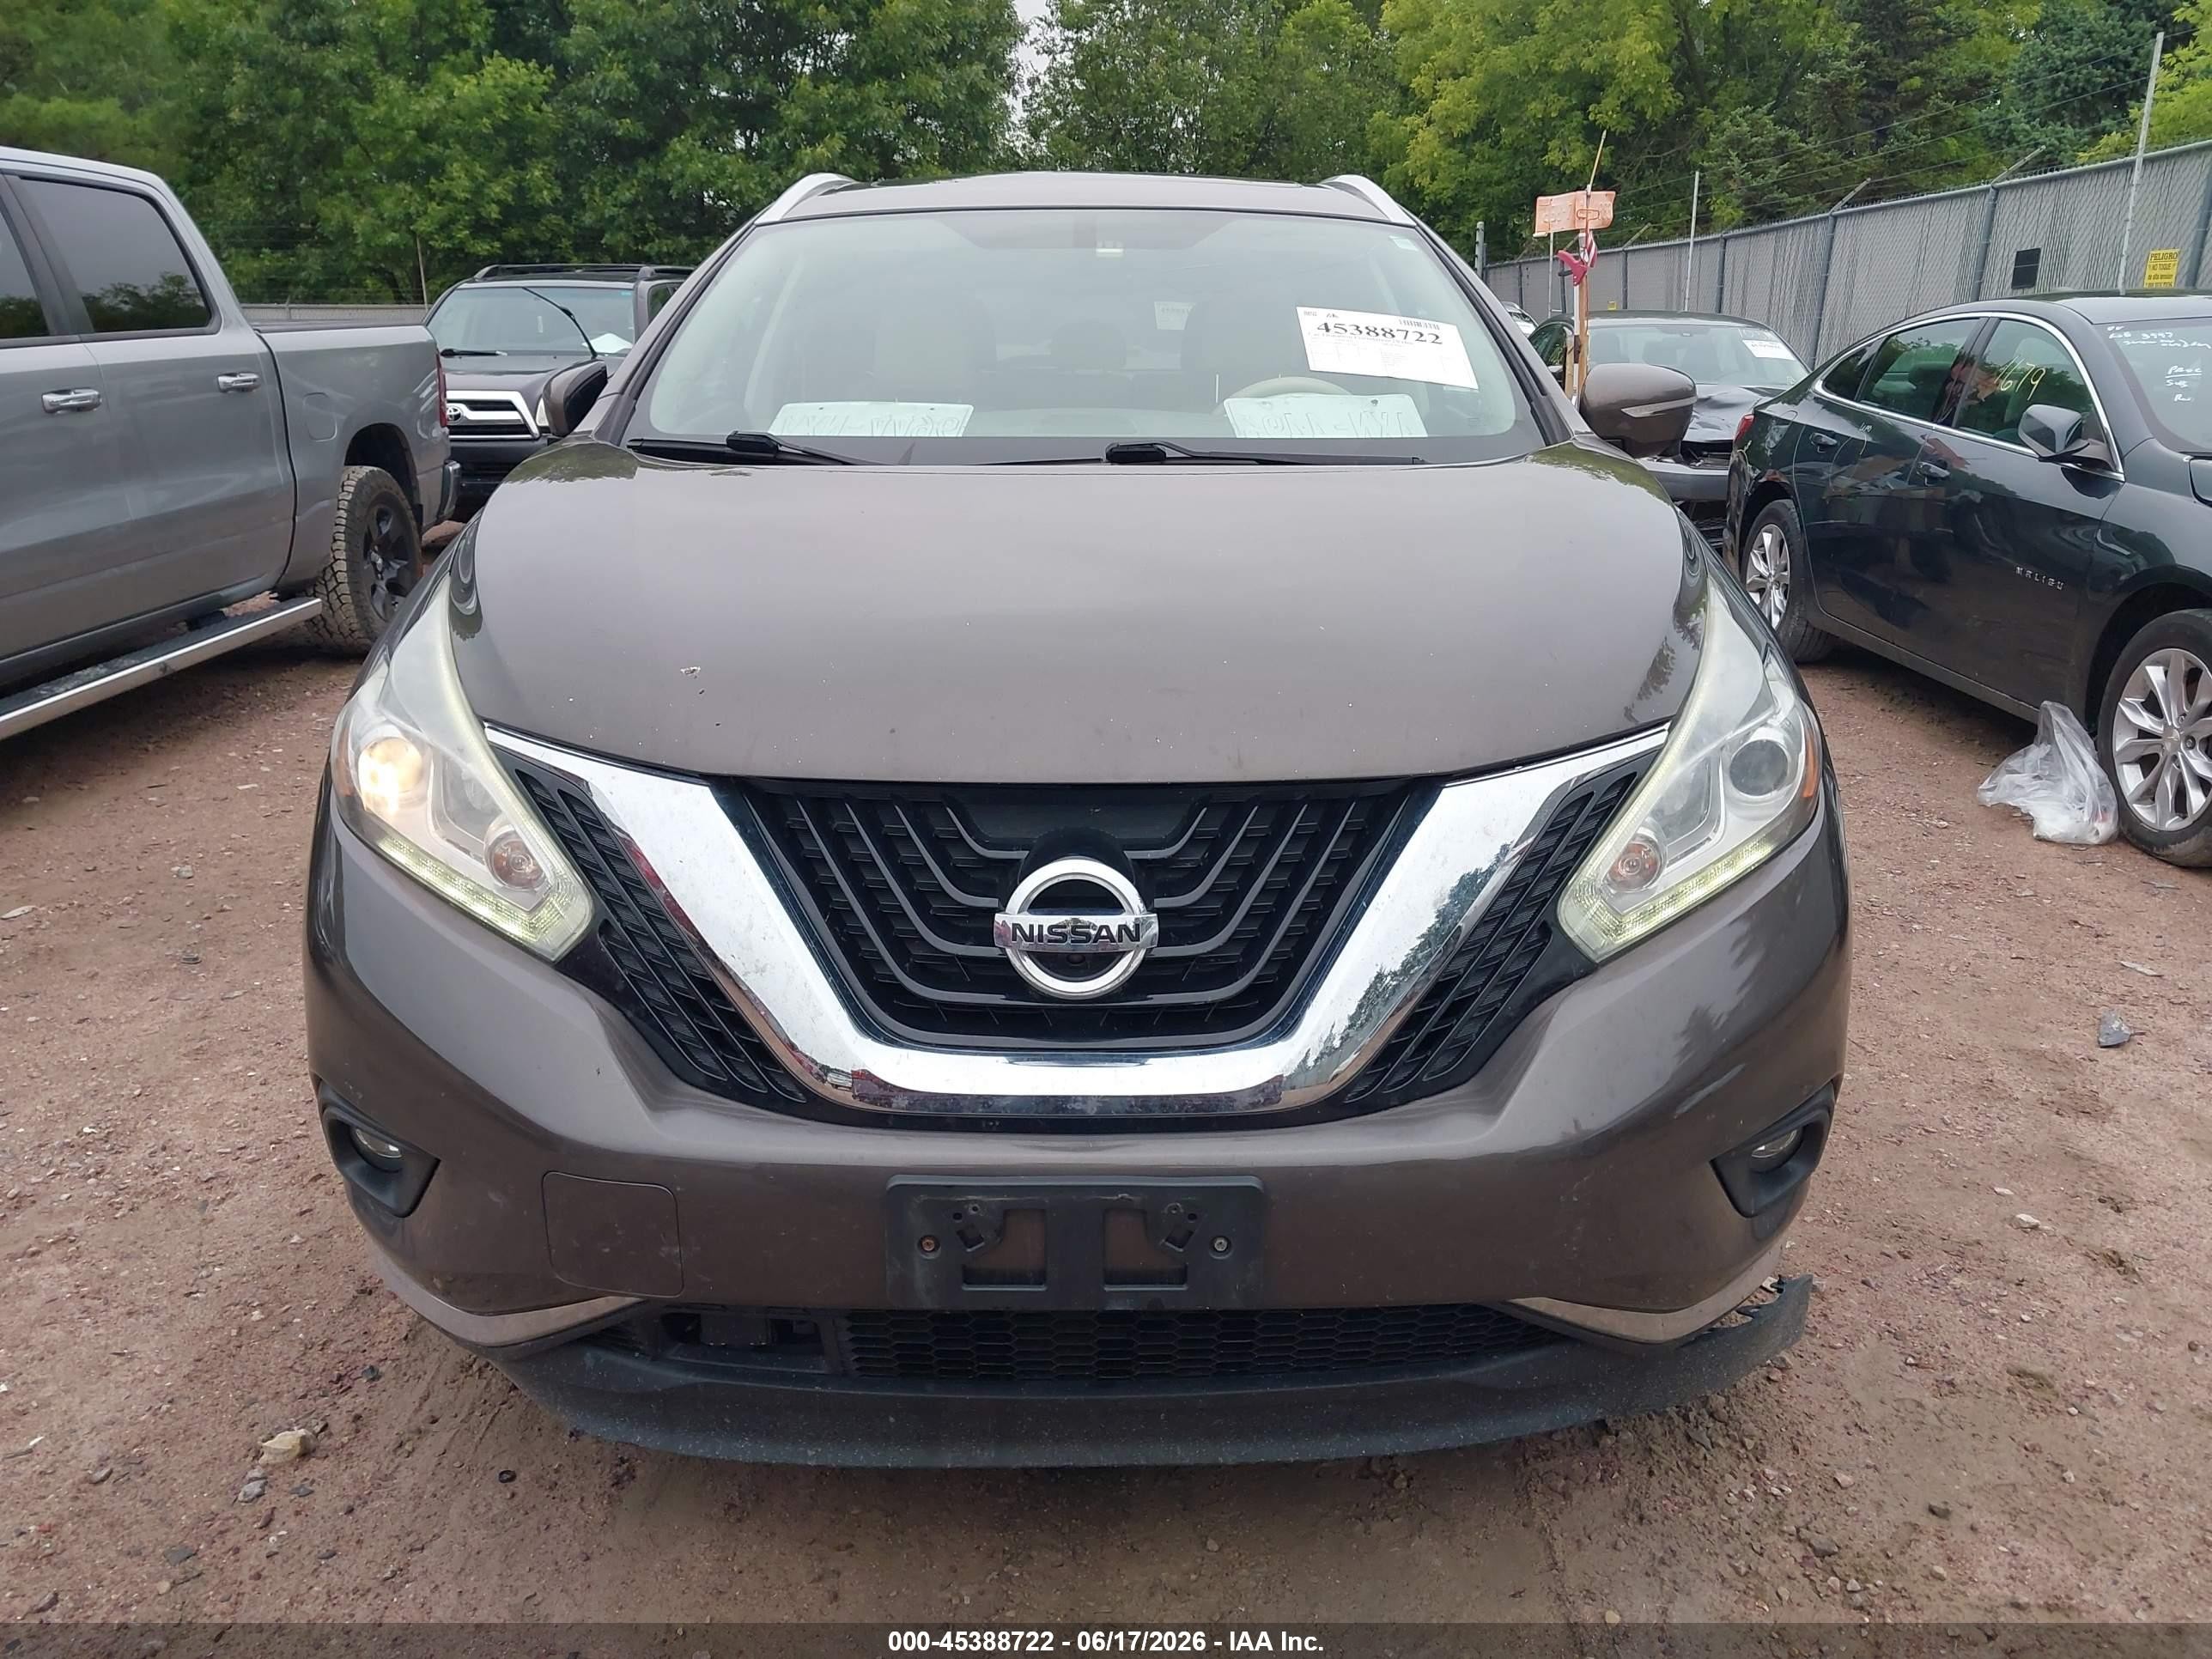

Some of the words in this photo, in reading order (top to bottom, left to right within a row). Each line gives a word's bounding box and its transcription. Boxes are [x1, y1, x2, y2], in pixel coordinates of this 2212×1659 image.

[2149, 252, 2179, 261] PELIGRO
[1316, 322, 1443, 344] 45388722
[1993, 356, 2047, 401] 1679
[1011, 922, 1141, 944] NISSAN
